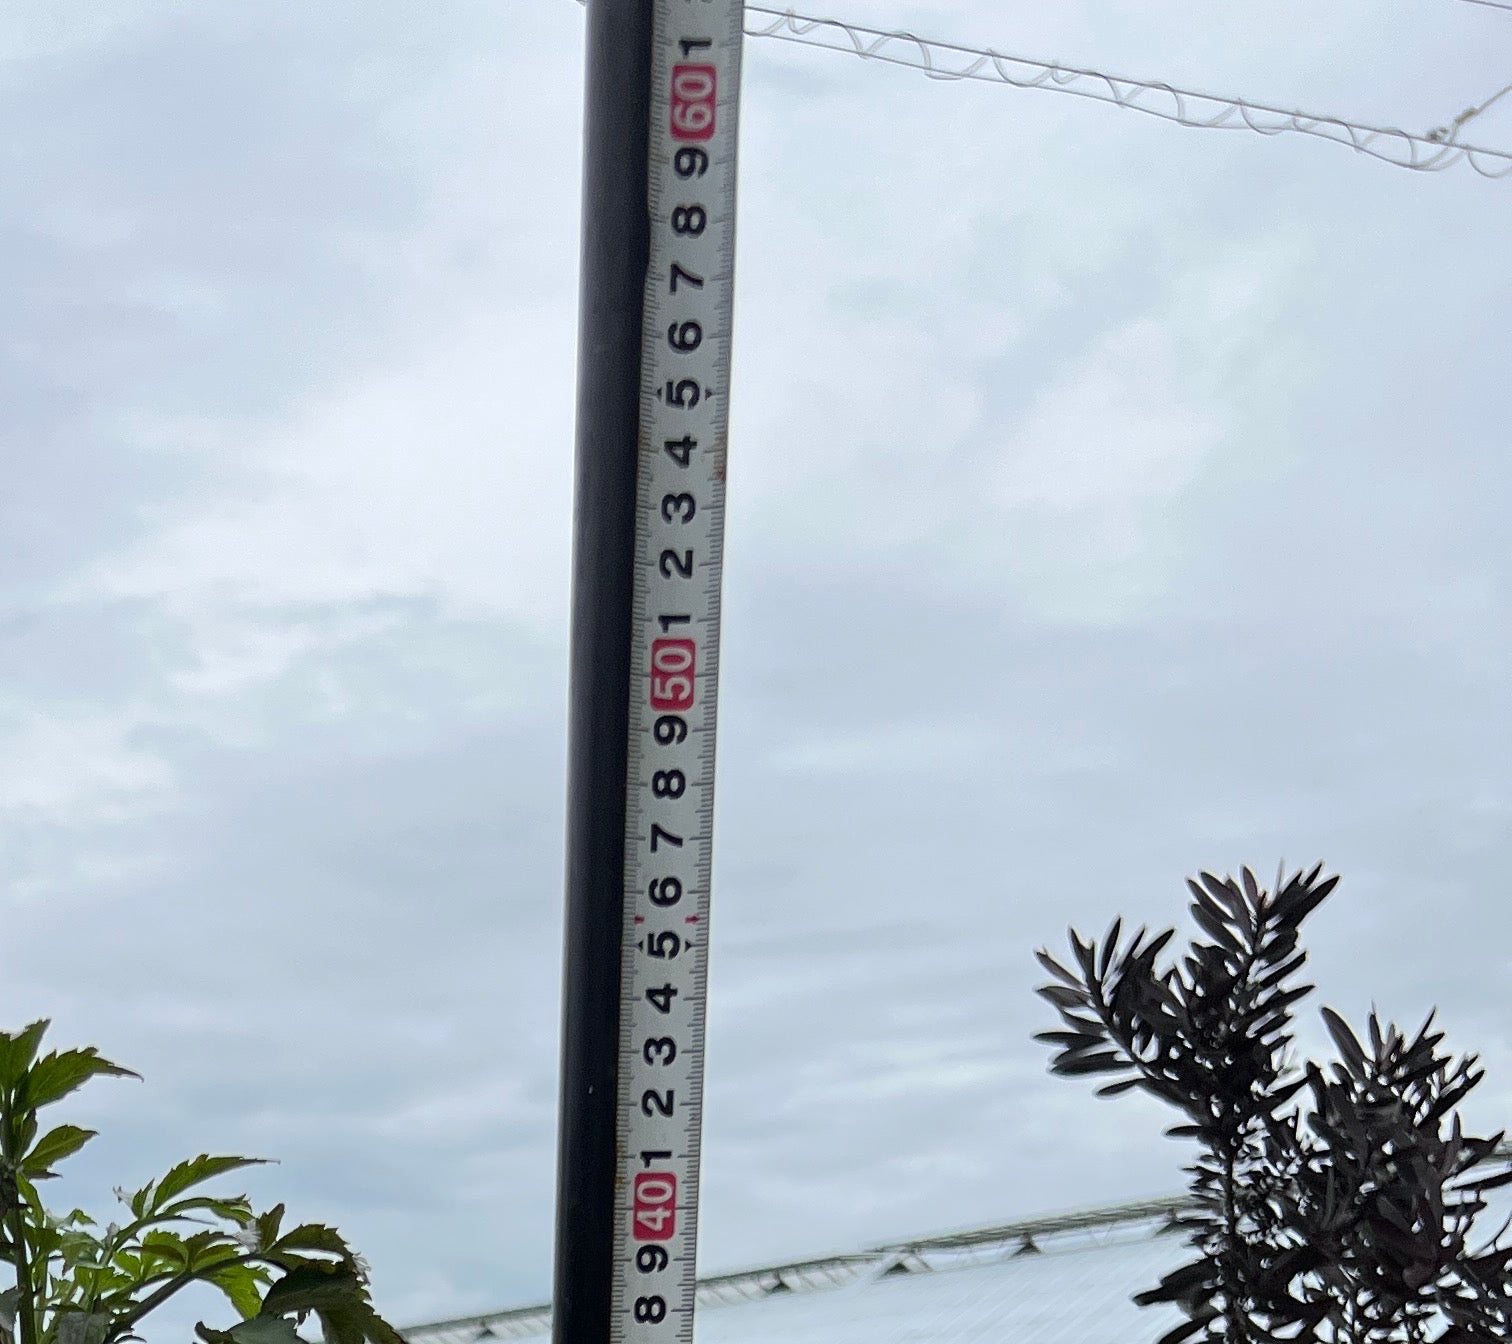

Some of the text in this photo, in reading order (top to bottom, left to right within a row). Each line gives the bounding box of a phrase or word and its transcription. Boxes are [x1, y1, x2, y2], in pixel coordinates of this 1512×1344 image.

[678, 37, 713, 57] 1
[672, 71, 714, 130] 60
[673, 145, 709, 180] 9
[670, 204, 707, 237] 8
[669, 261, 704, 295] 7
[667, 319, 703, 354] 6
[665, 378, 701, 410] 5
[663, 435, 698, 469] 4
[660, 492, 697, 525] 3
[658, 548, 694, 580] 2
[657, 614, 691, 634] 1
[655, 647, 692, 699] 50
[653, 714, 688, 746] 9
[651, 768, 686, 800] 8
[650, 823, 684, 854] 7
[647, 876, 683, 908] 6
[647, 930, 681, 960] 5
[645, 983, 679, 1014] 4
[642, 1036, 677, 1067] 3
[641, 1089, 675, 1118] 2
[639, 1150, 673, 1169] 1
[637, 1180, 673, 1230] 40
[635, 1243, 669, 1274] 9
[633, 1295, 667, 1325] 8
